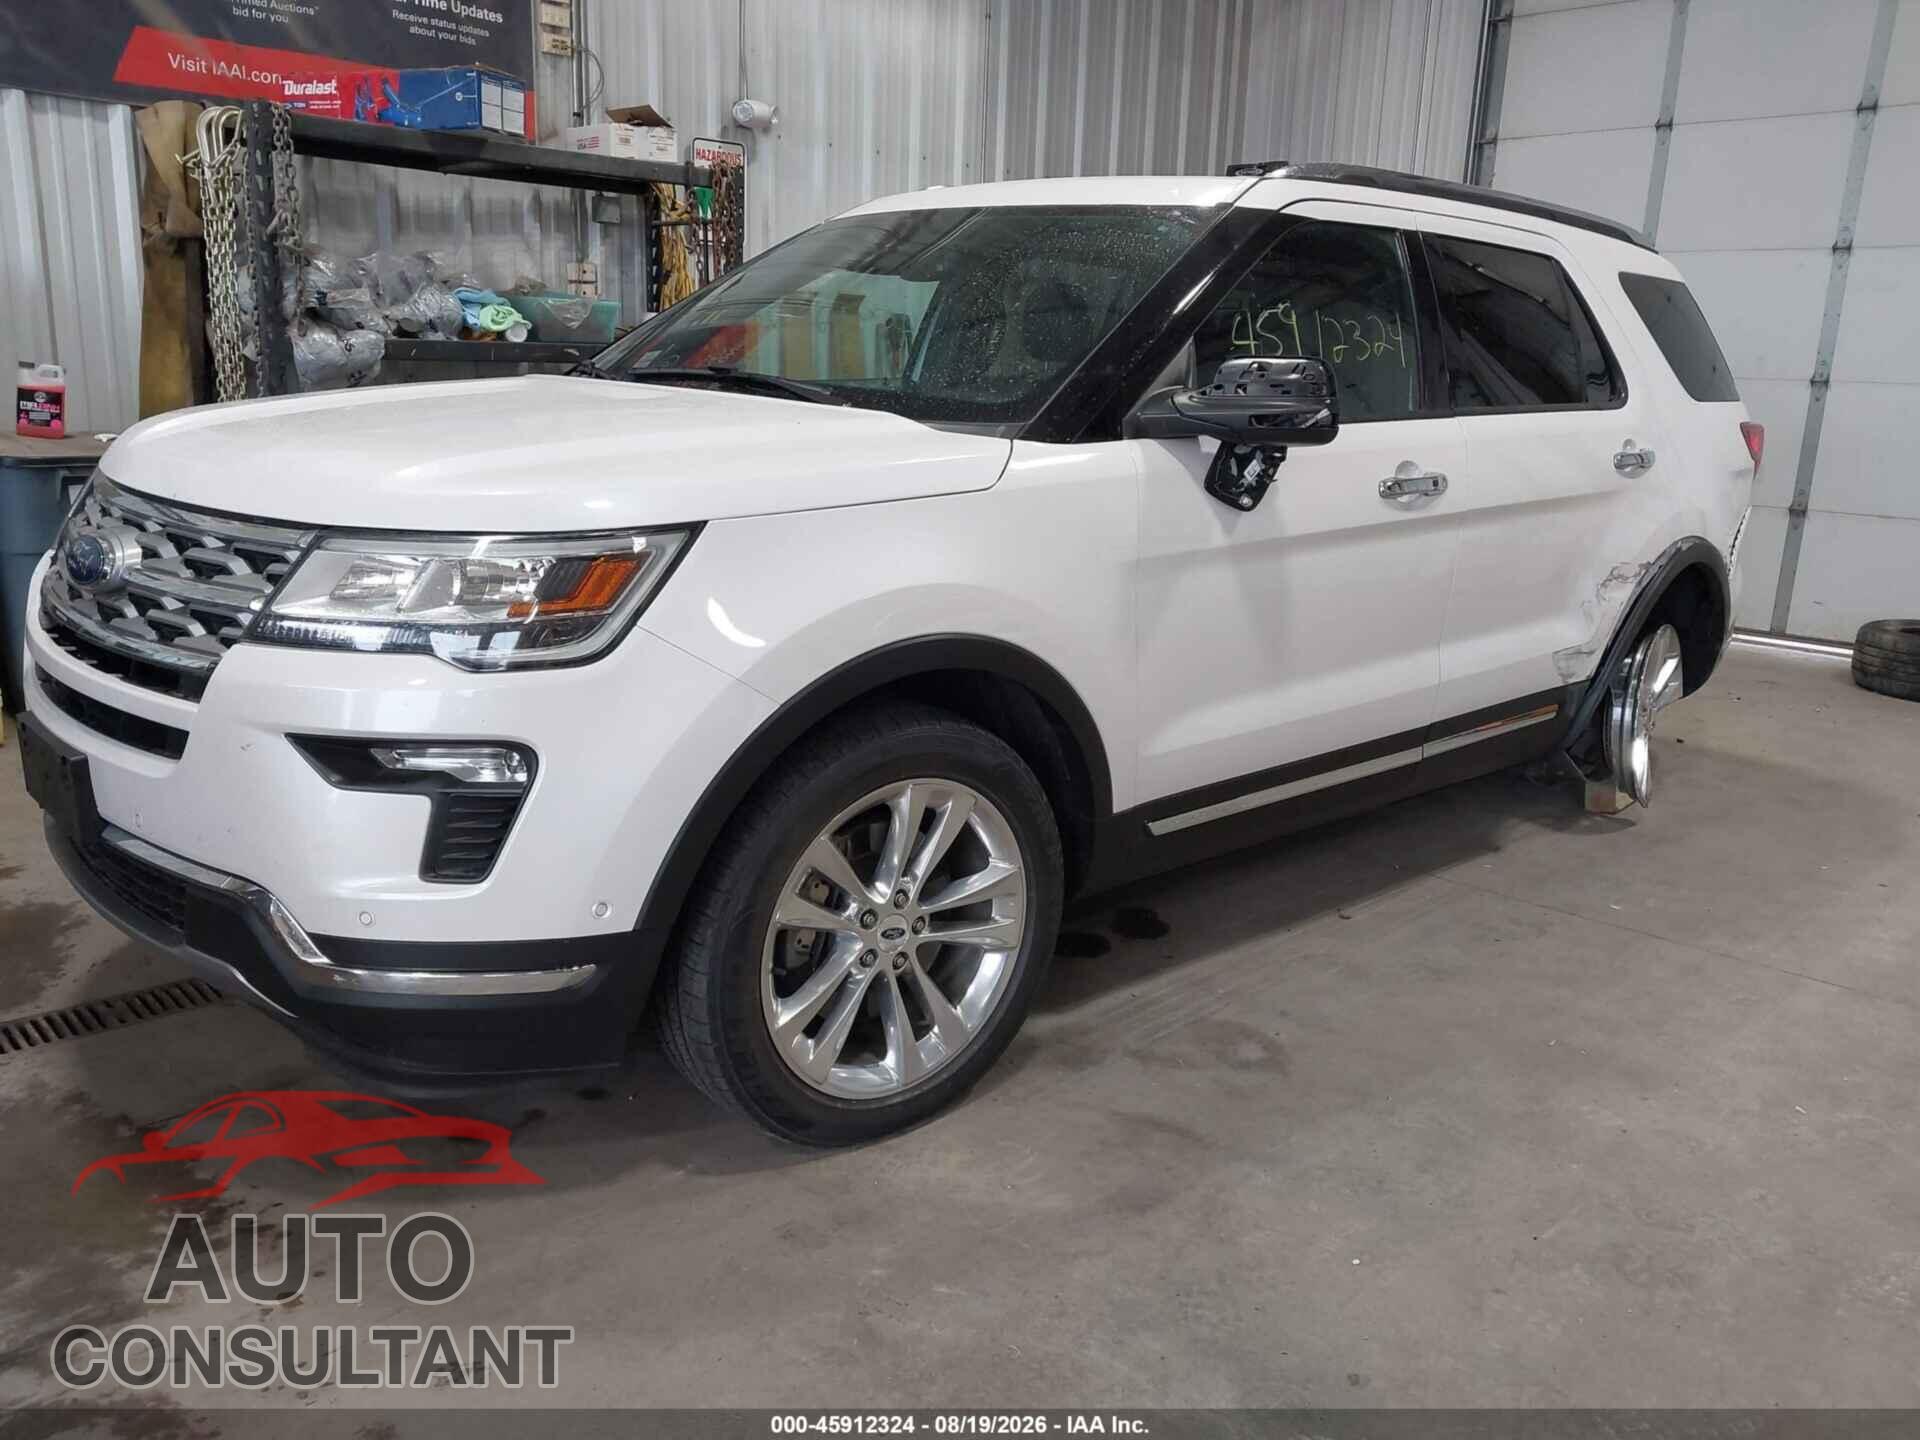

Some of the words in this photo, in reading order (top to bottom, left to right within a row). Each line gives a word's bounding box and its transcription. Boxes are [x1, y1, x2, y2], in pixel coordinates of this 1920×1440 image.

[232, 5, 249, 17] bid
[251, 8, 267, 19] for
[270, 13, 289, 23] you
[451, 0, 504, 23] Updates
[392, 9, 428, 24] Receive
[430, 18, 456, 30] status
[458, 23, 490, 37] updates
[409, 26, 436, 38] about
[438, 30, 457, 41] your
[459, 34, 477, 45] bids
[167, 52, 208, 74] Visit
[282, 79, 337, 96] Duralast
[695, 147, 742, 166] HAZARDOUS
